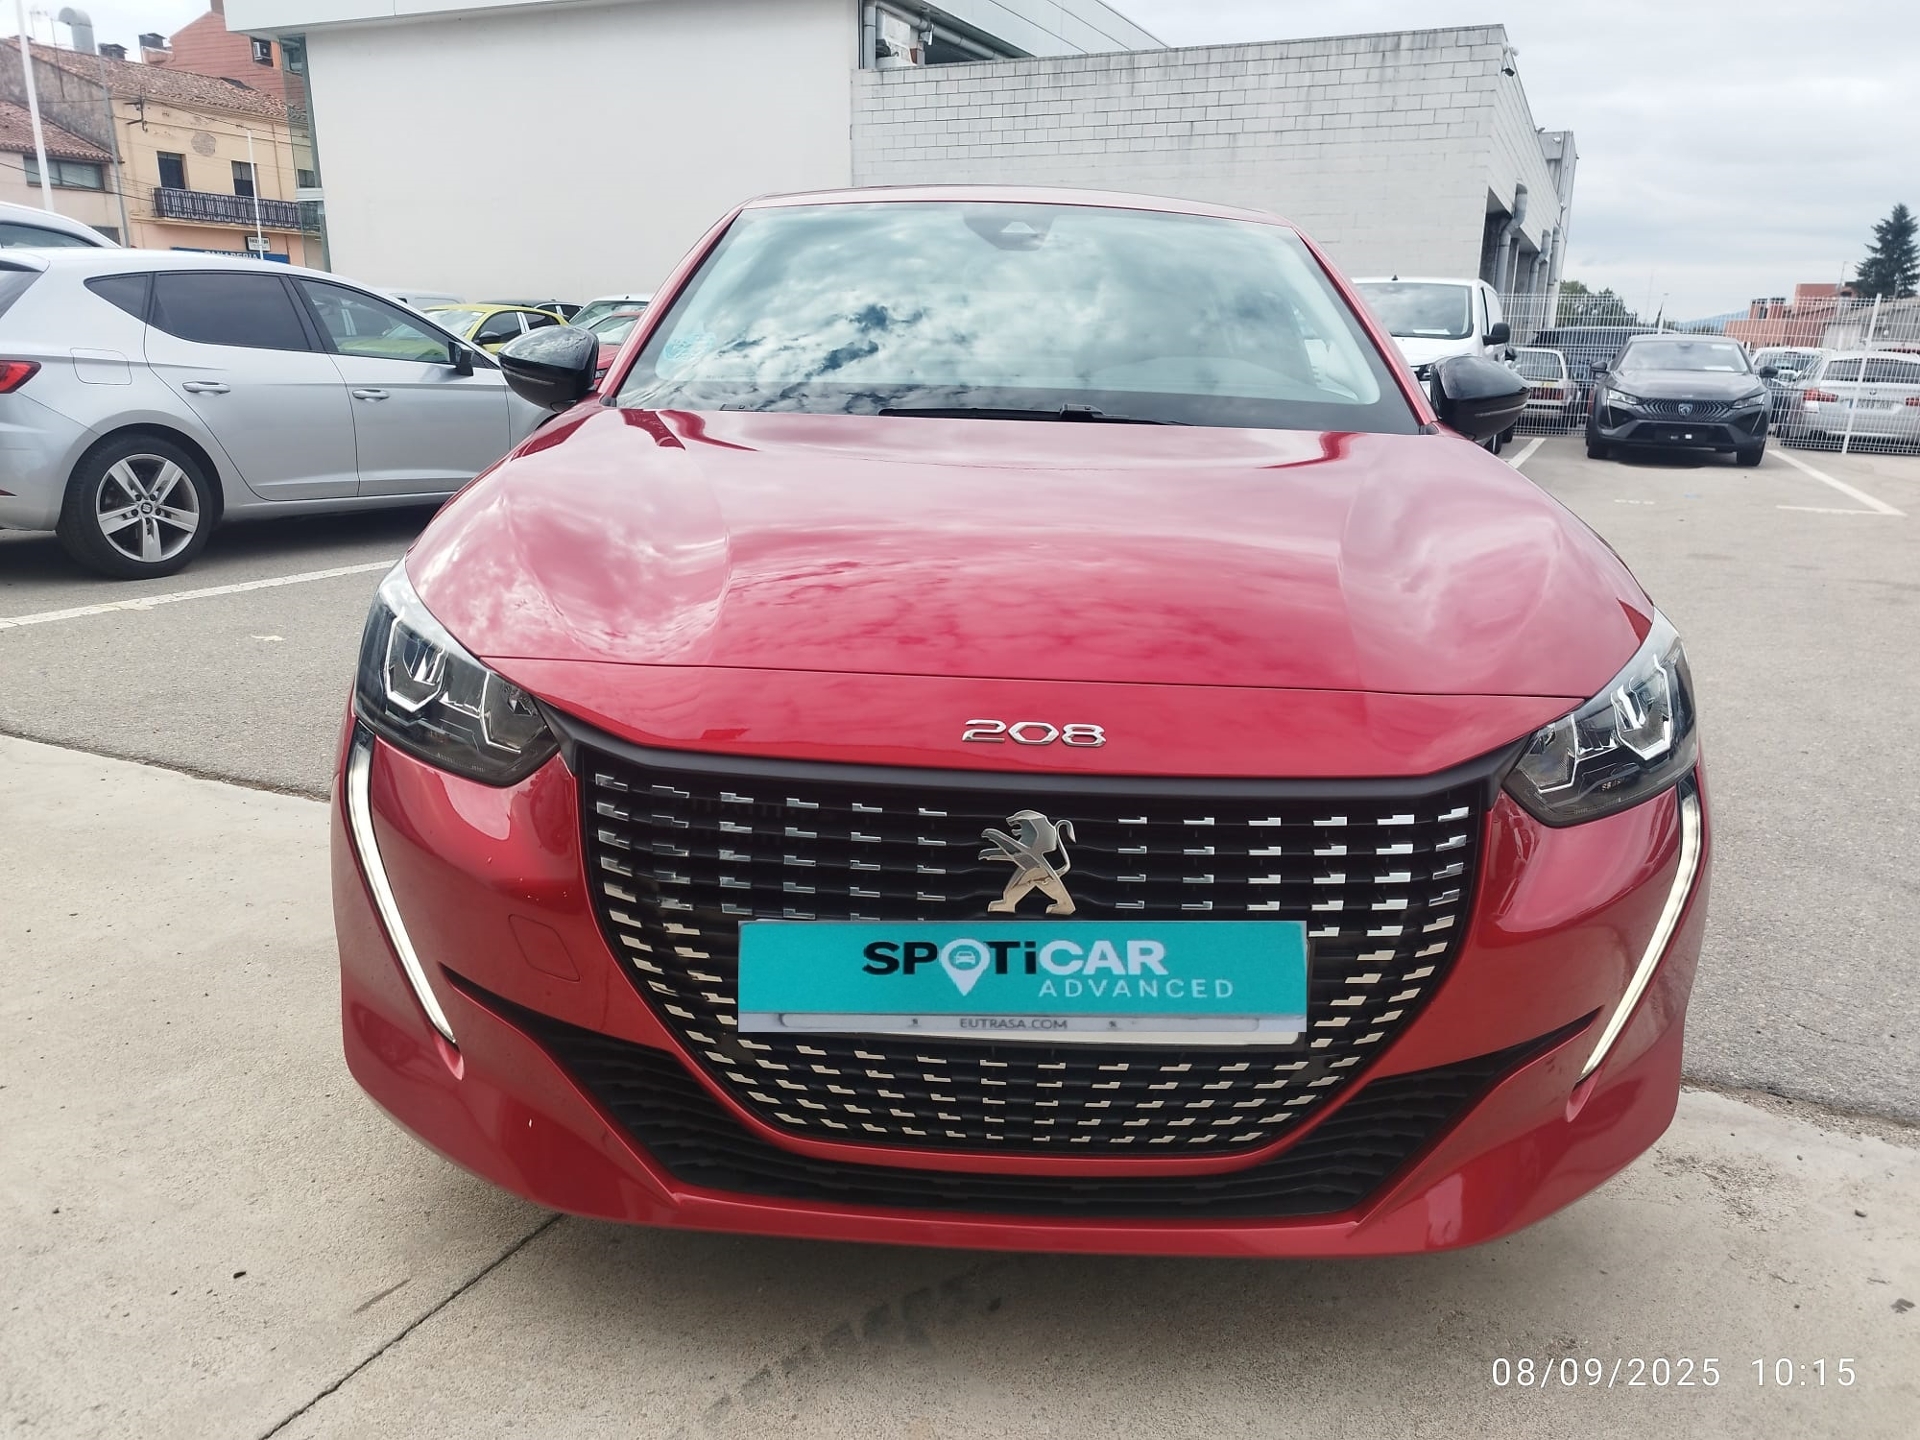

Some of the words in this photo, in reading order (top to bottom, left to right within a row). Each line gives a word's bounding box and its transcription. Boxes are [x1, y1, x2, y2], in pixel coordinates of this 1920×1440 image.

[962, 719, 1107, 747] 208
[1038, 979, 1234, 998] ADVANCED
[960, 1018, 1068, 1030] EUTRASA.COM
